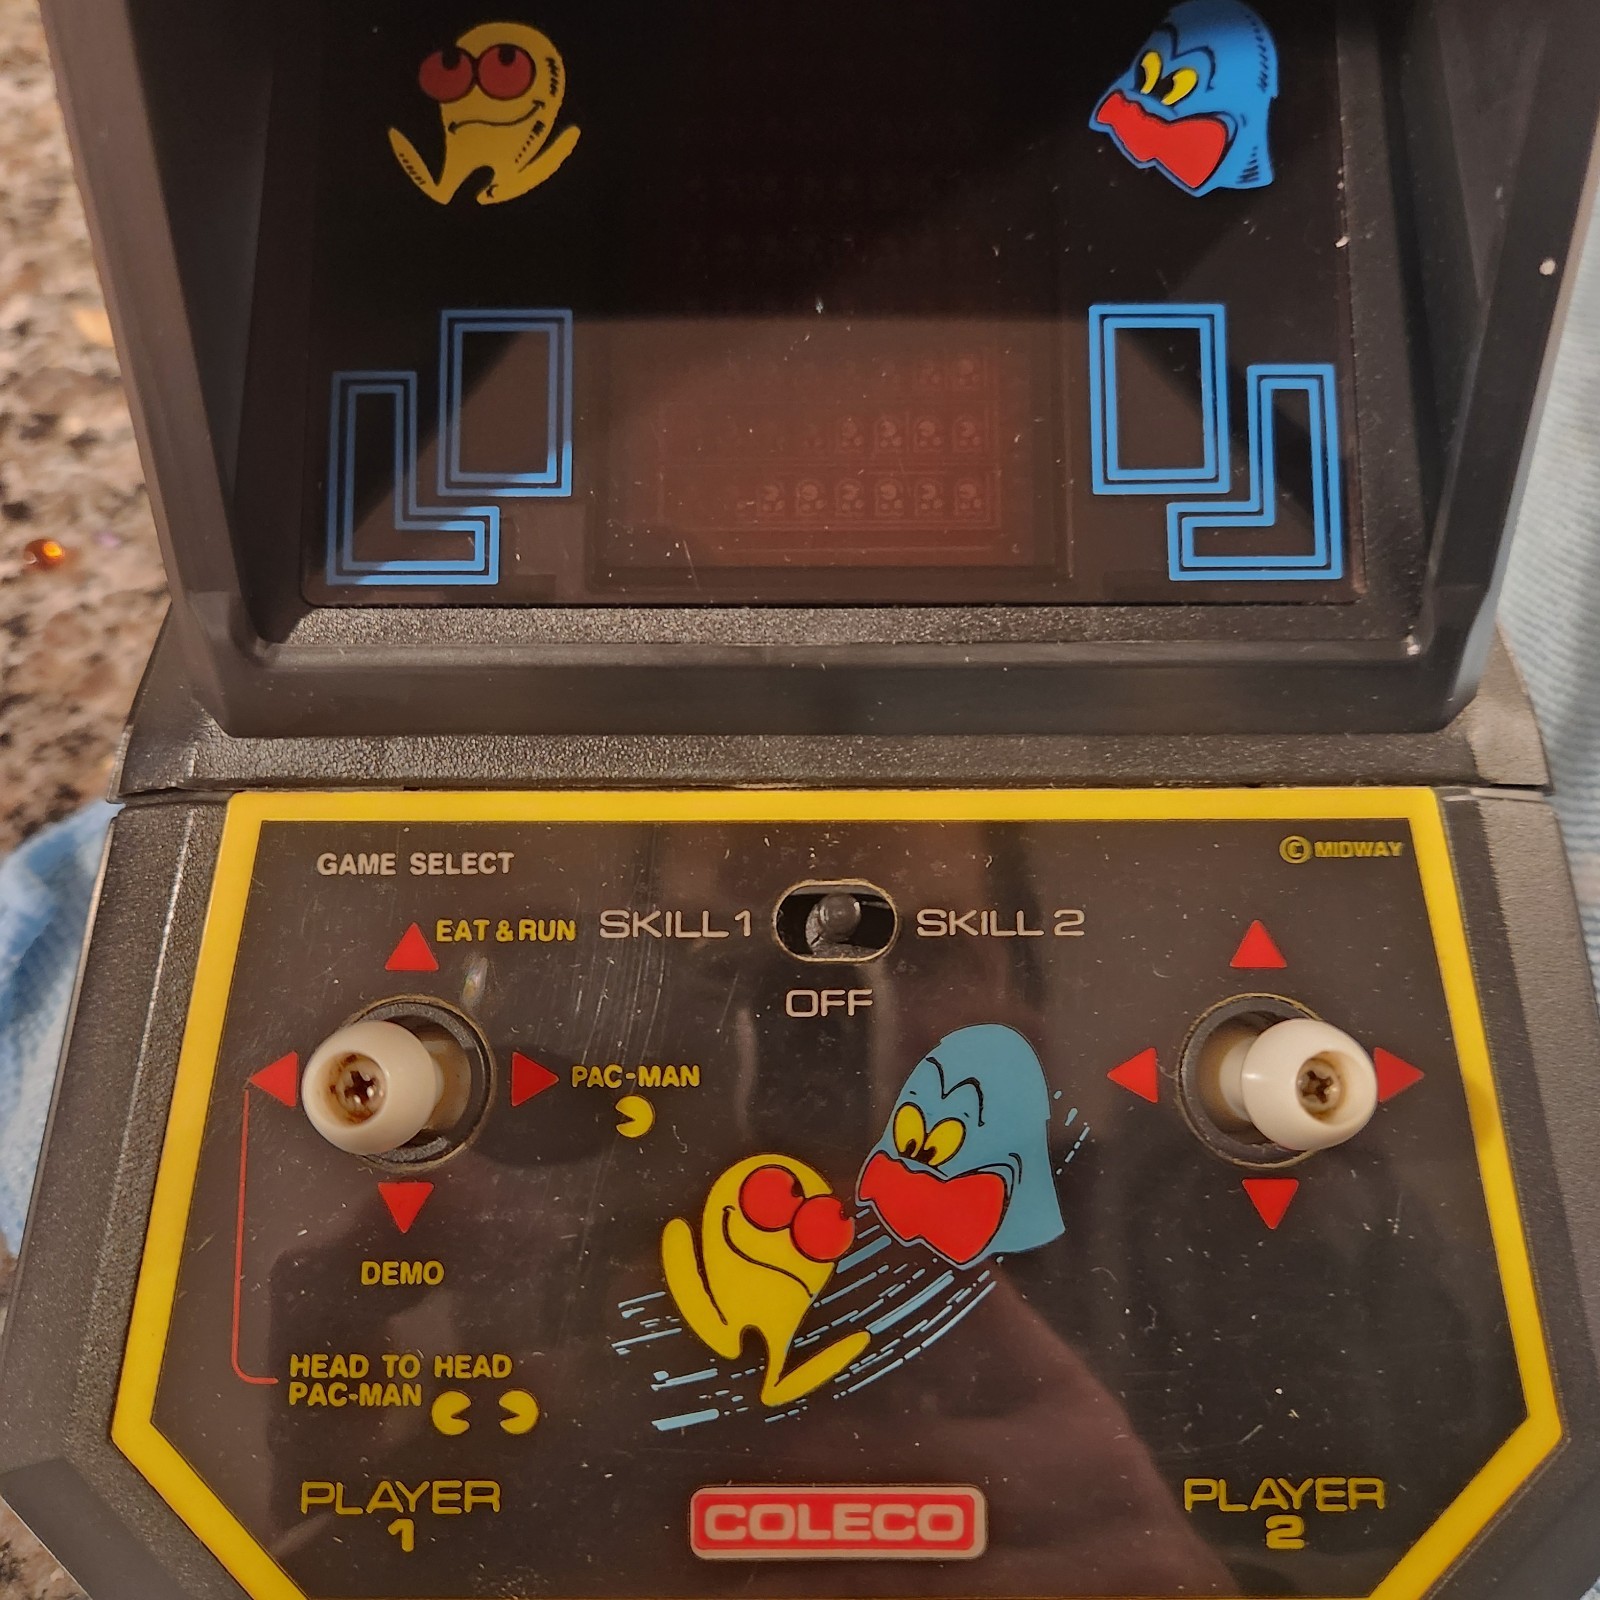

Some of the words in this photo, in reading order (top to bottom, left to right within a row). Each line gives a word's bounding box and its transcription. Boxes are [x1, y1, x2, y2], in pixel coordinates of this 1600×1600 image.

[316, 852, 396, 876] GAME
[409, 852, 514, 875] SELECT
[1315, 840, 1403, 859] MIDWAY
[435, 919, 486, 942] EAT
[495, 919, 514, 942] &
[518, 919, 577, 942] RUN
[599, 909, 729, 939] SKILL
[734, 910, 752, 937] 1
[916, 908, 1044, 938] SKILL
[1053, 908, 1085, 938] 2
[784, 988, 874, 1018] OFF
[570, 1064, 701, 1089] PAC-MAN
[360, 1260, 445, 1286] DEMO
[289, 1353, 369, 1379] HEAD
[382, 1353, 421, 1379] TO
[433, 1353, 513, 1379] HEAD
[288, 1382, 423, 1407] PAC-MAN
[300, 1479, 501, 1515] PLAYER
[1183, 1476, 1387, 1513] PLAYER
[387, 1518, 415, 1552] 1
[703, 1502, 966, 1542] COLECO
[1264, 1515, 1305, 1550] 2
